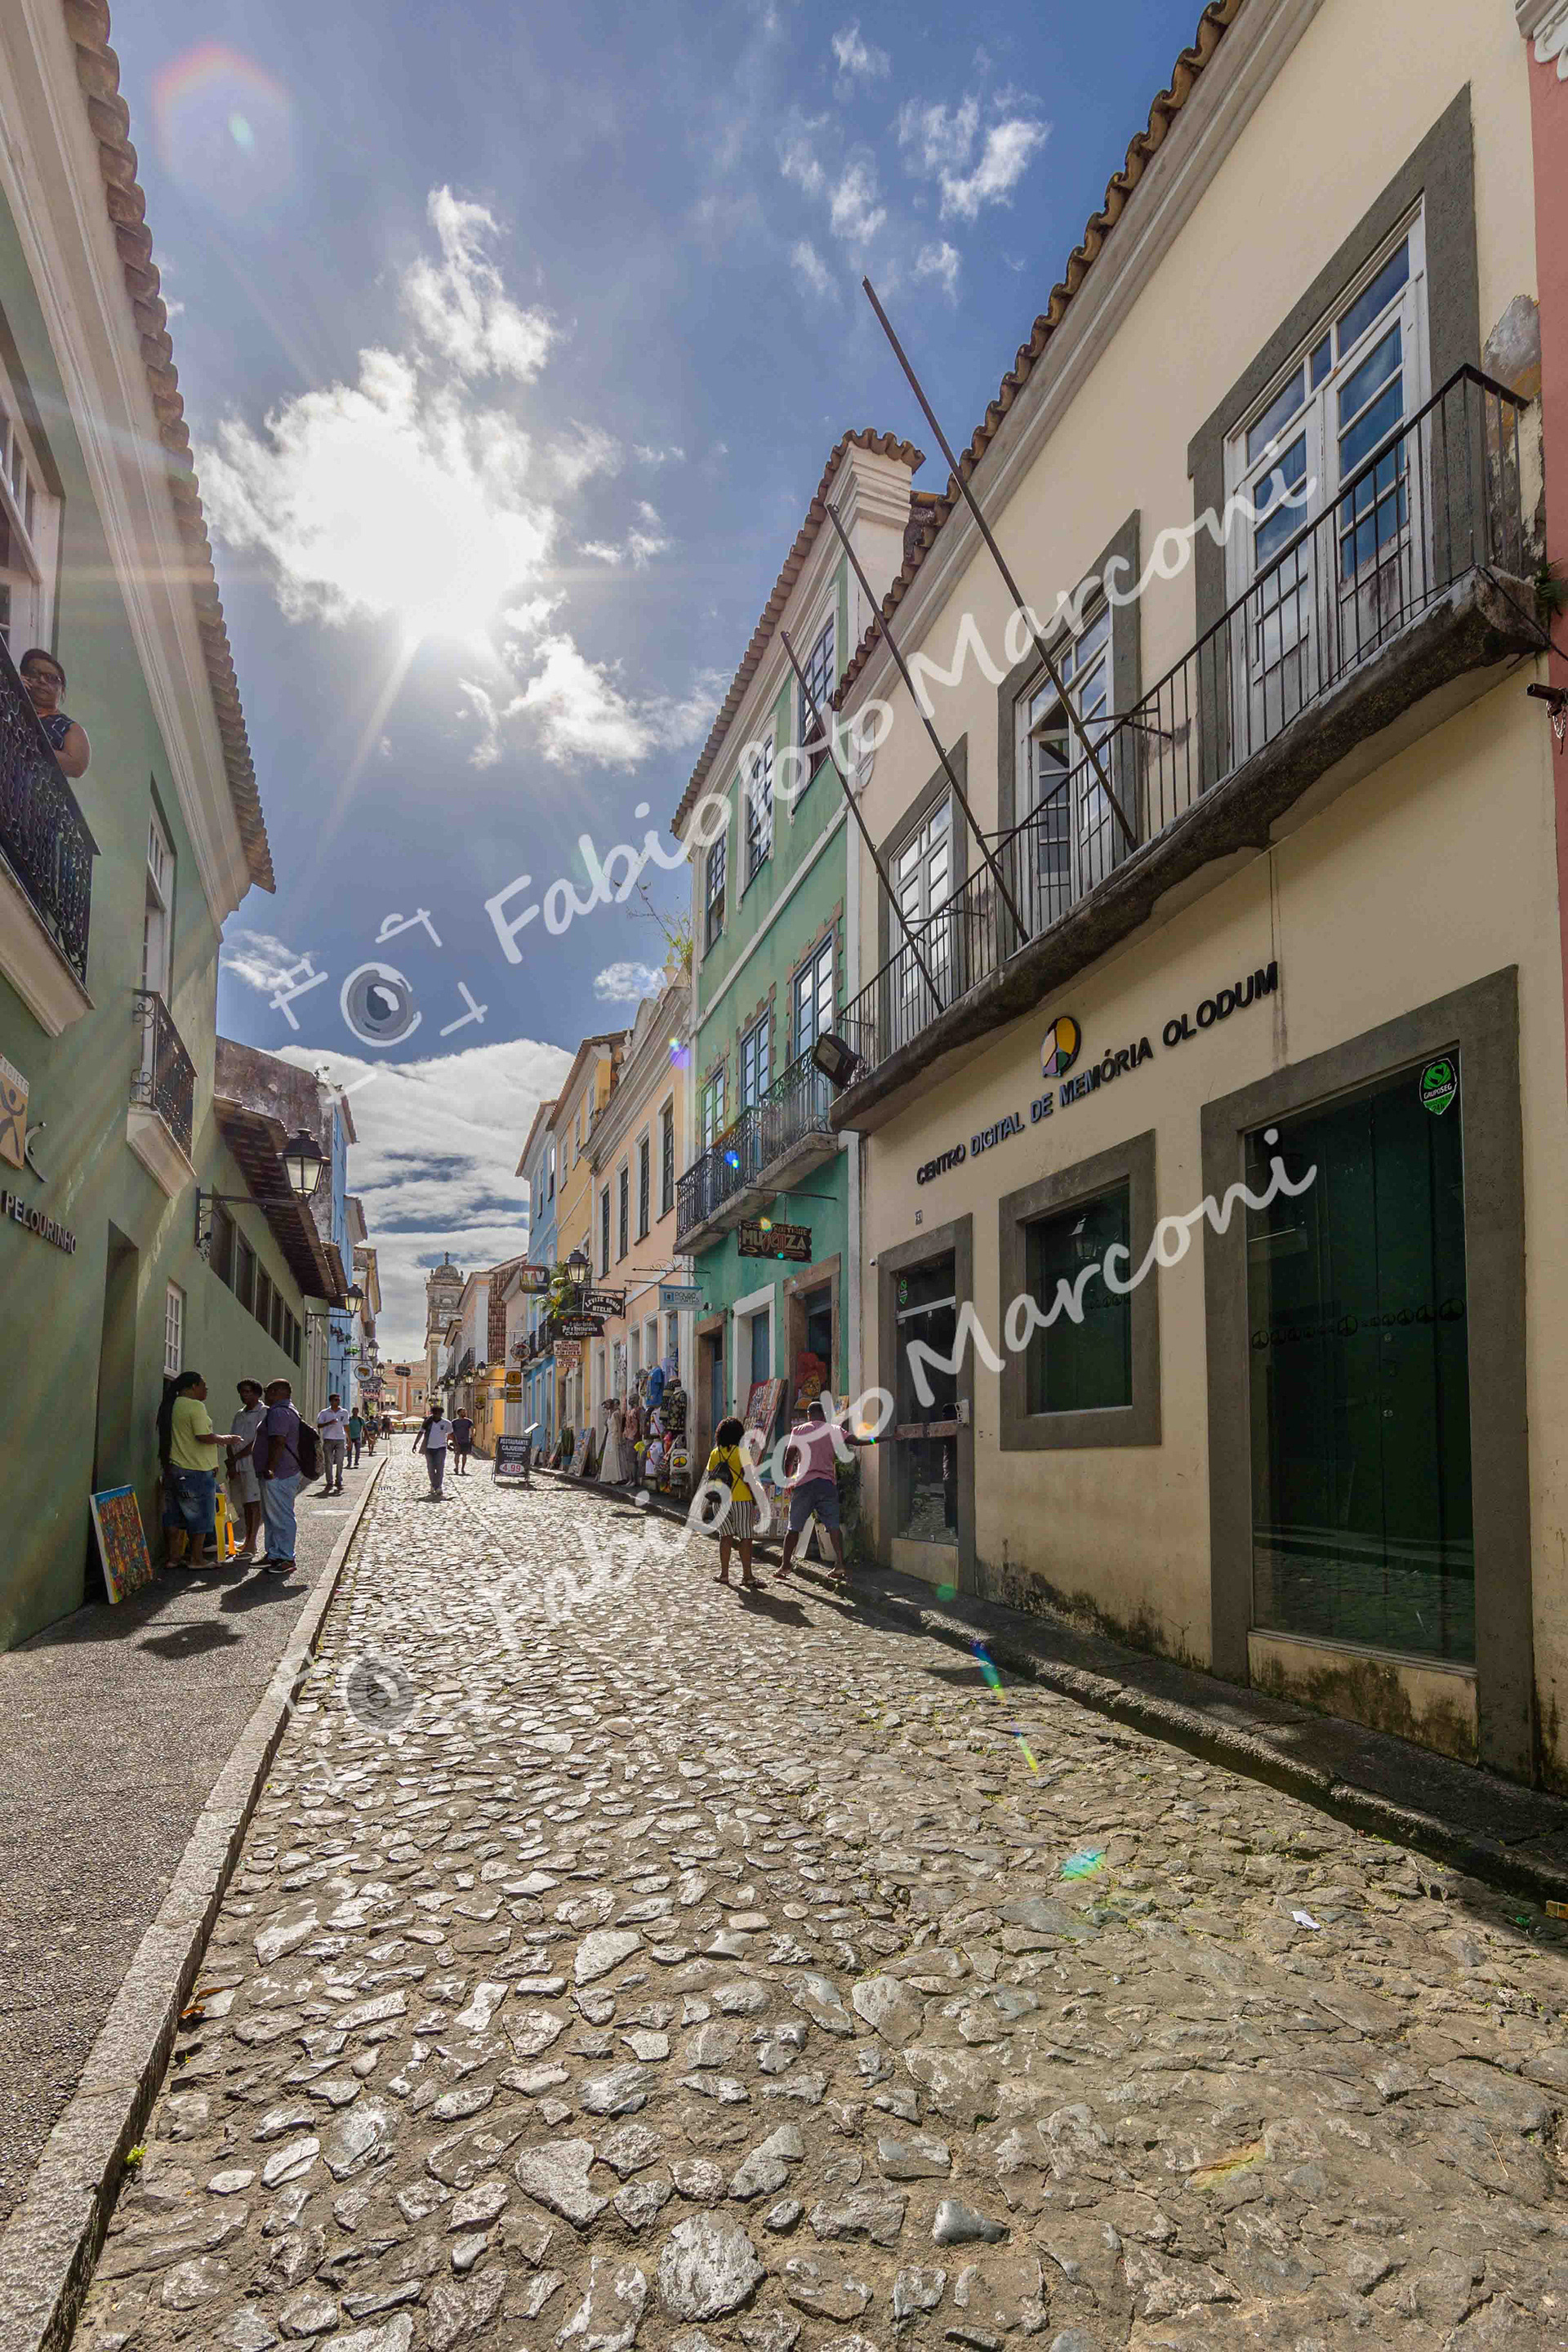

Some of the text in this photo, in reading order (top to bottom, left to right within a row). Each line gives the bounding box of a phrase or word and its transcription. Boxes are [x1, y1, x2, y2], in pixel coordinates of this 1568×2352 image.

[916, 960, 1278, 1185] CENTRO DIGITAL DE MEMÓRIA OLODUM
[2, 1191, 76, 1254] PELOURINHO
[500, 1437, 528, 1446] RESTAURANTE
